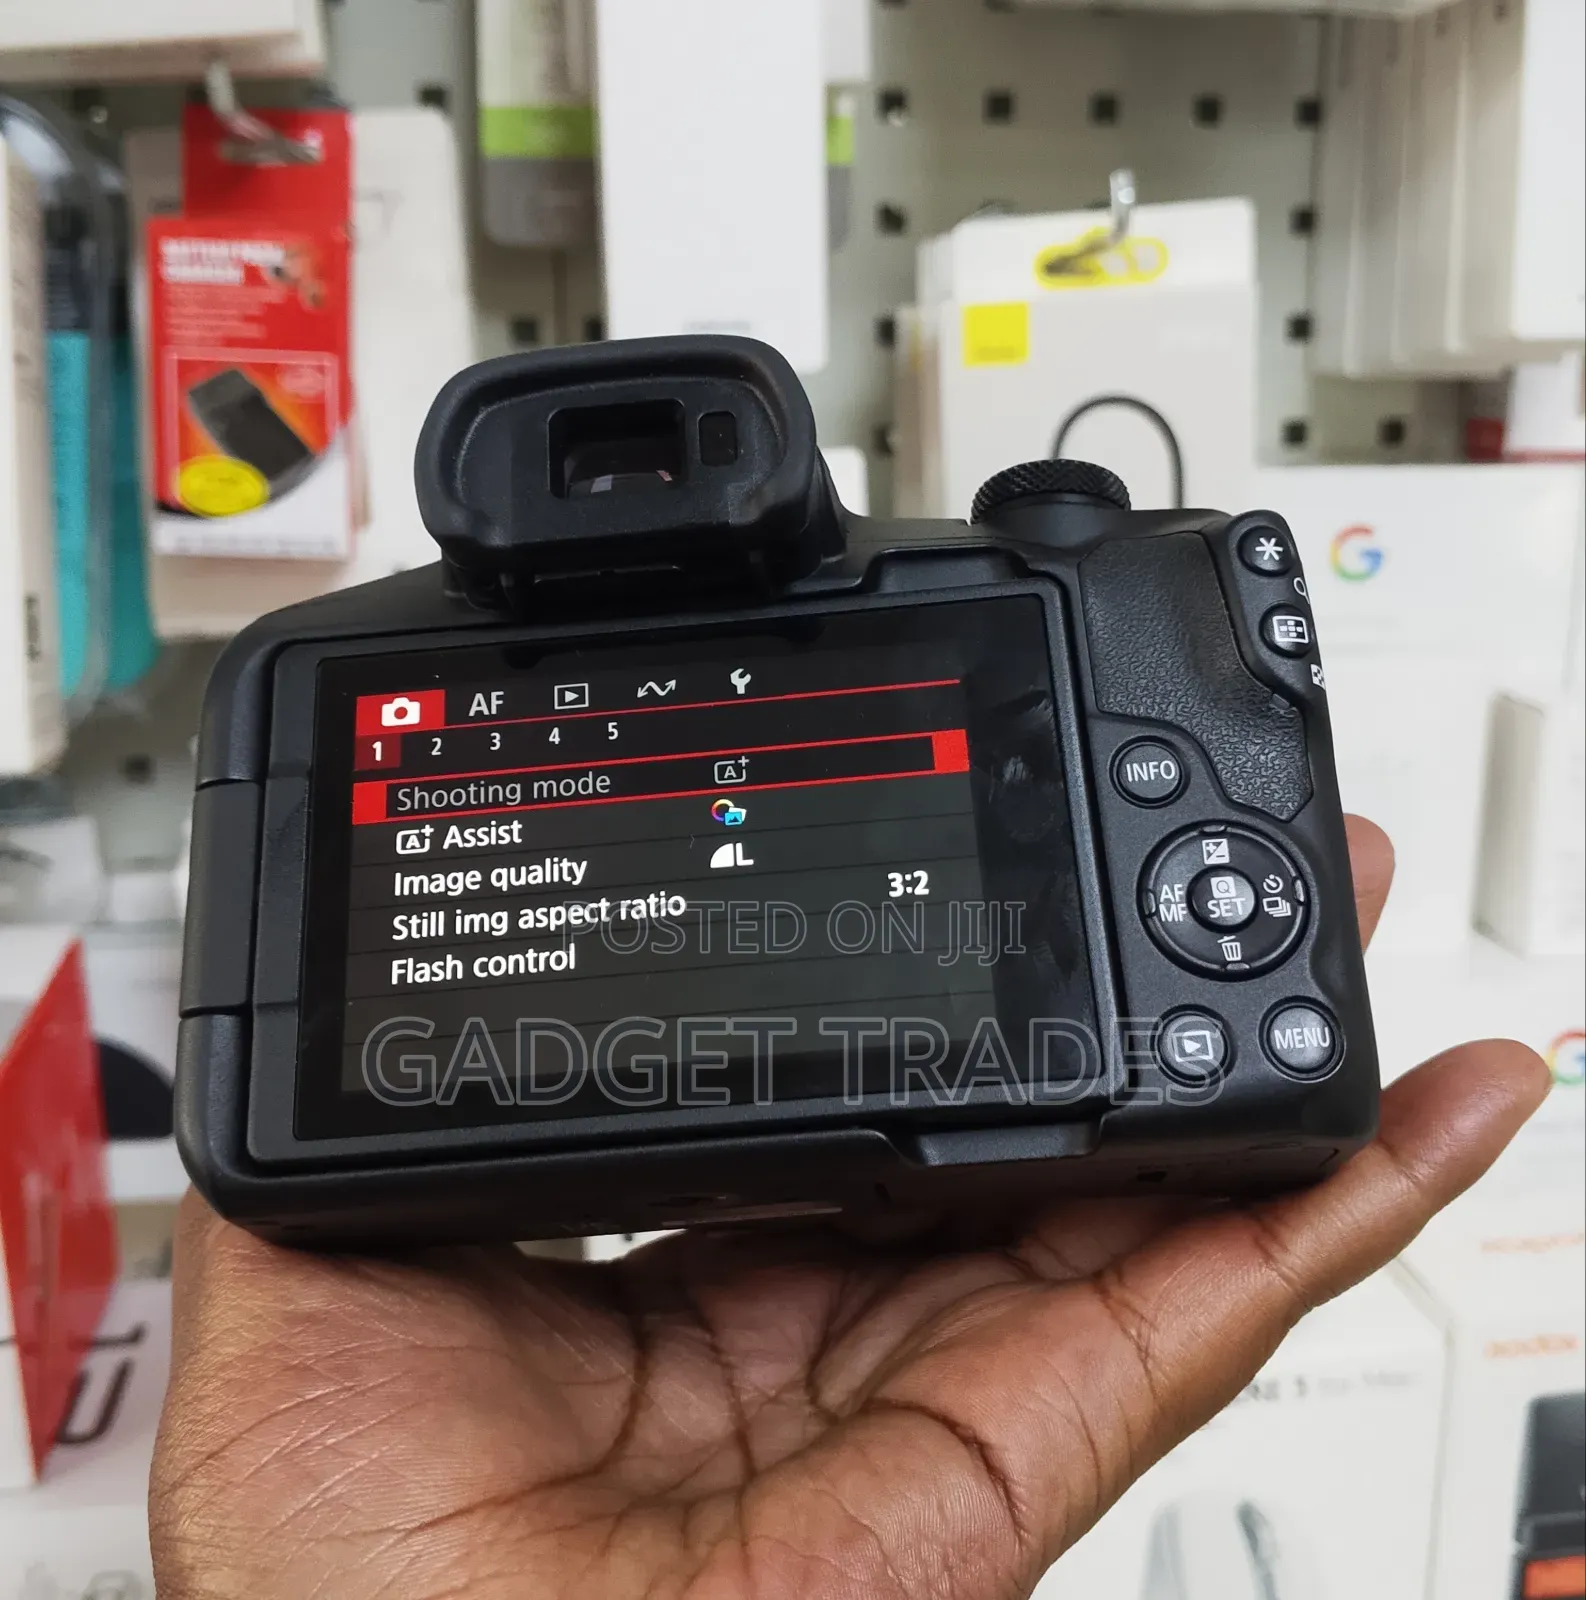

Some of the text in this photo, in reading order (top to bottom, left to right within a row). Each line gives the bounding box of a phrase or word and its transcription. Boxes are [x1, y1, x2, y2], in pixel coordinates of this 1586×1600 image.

[468, 691, 504, 717] AF
[372, 722, 619, 761] 1 2 3 4 5
[1126, 760, 1177, 783] INFO
[397, 771, 611, 811] Shooting mode
[442, 820, 523, 850] Assist
[394, 857, 588, 897] Image quality
[887, 870, 930, 898] 3:2
[1159, 884, 1184, 902] AF
[392, 891, 687, 940] Still img aspect ratio
[1159, 902, 1188, 922] MF
[1206, 898, 1246, 919] SET
[391, 943, 576, 985] Flash control
[1274, 1027, 1331, 1050] MENU
